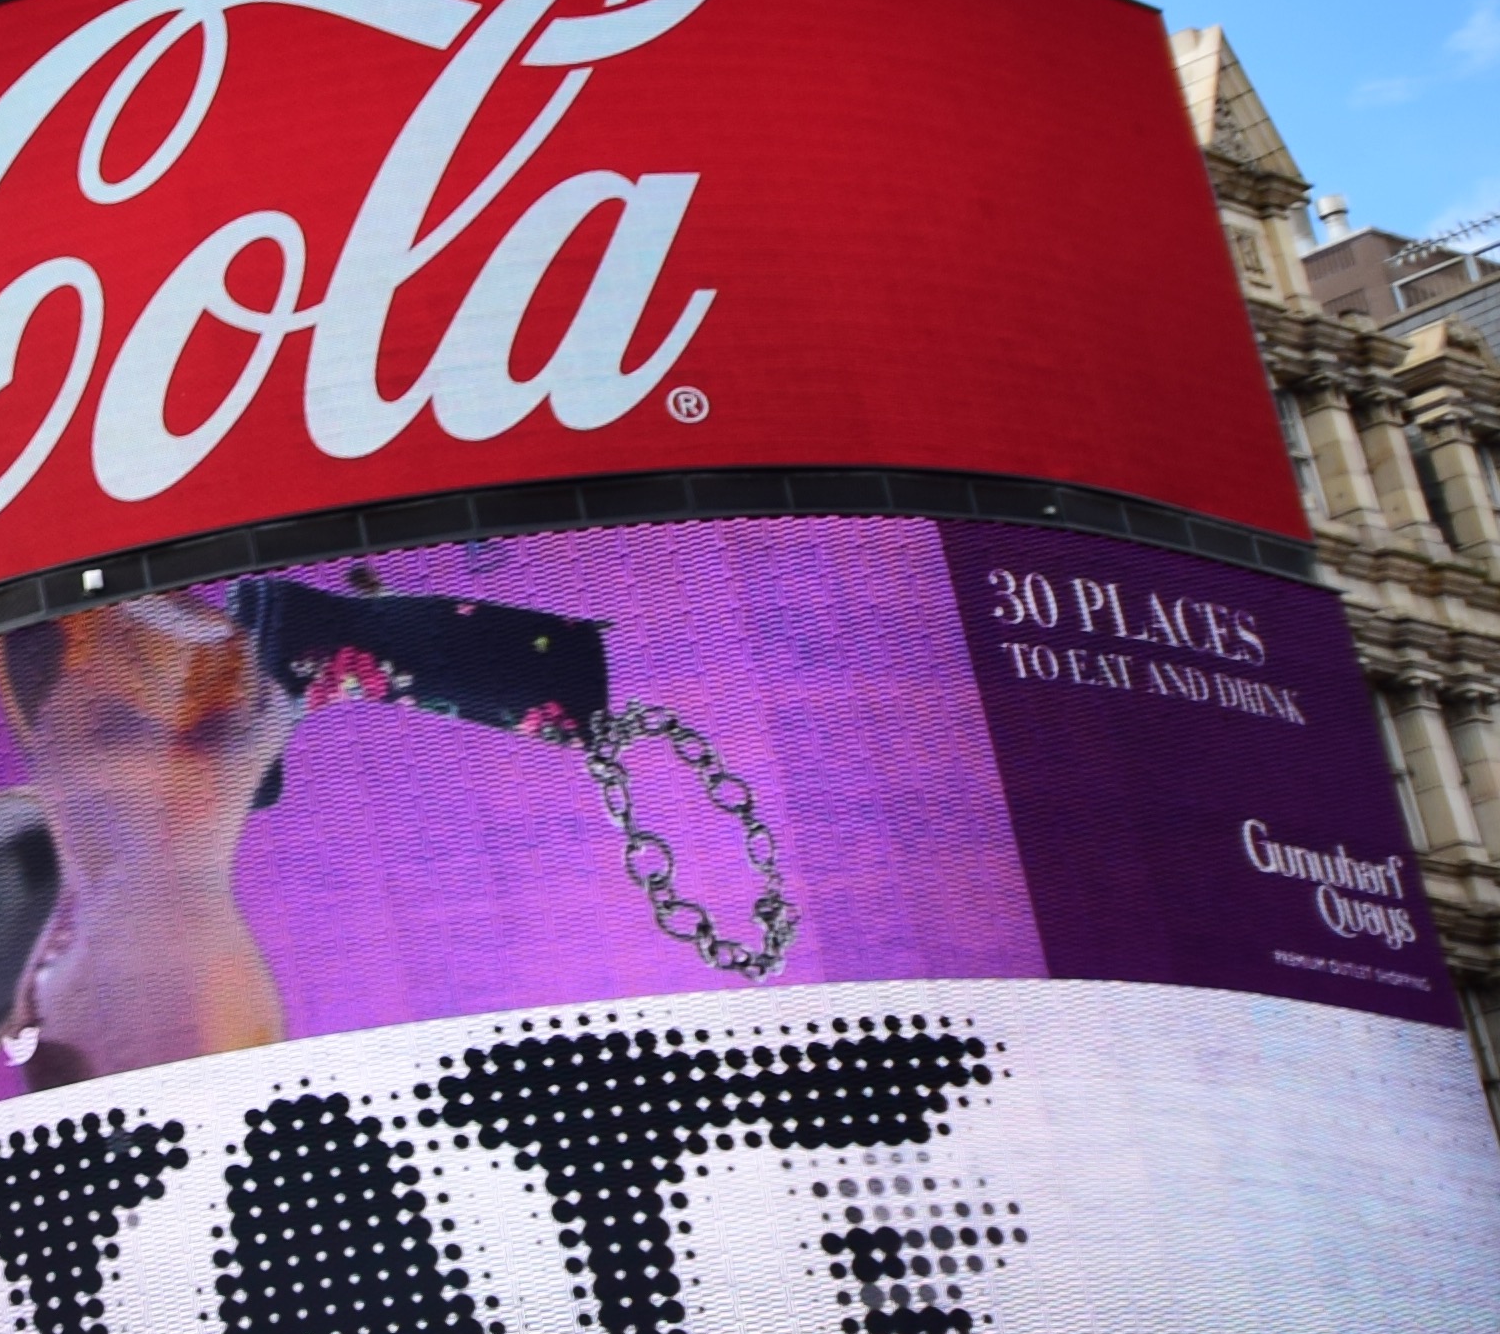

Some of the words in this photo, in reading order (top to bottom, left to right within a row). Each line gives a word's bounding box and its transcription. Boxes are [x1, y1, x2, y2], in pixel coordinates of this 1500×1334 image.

[988, 568, 1058, 628] 30
[1070, 577, 1266, 666] PLACES
[1001, 642, 1059, 681] TO
[1067, 648, 1133, 689] EAT
[1148, 660, 1209, 702] AND
[1214, 673, 1306, 727] DRINK
[1242, 819, 1403, 899] Gunwharf
[1316, 884, 1416, 950] Quays
